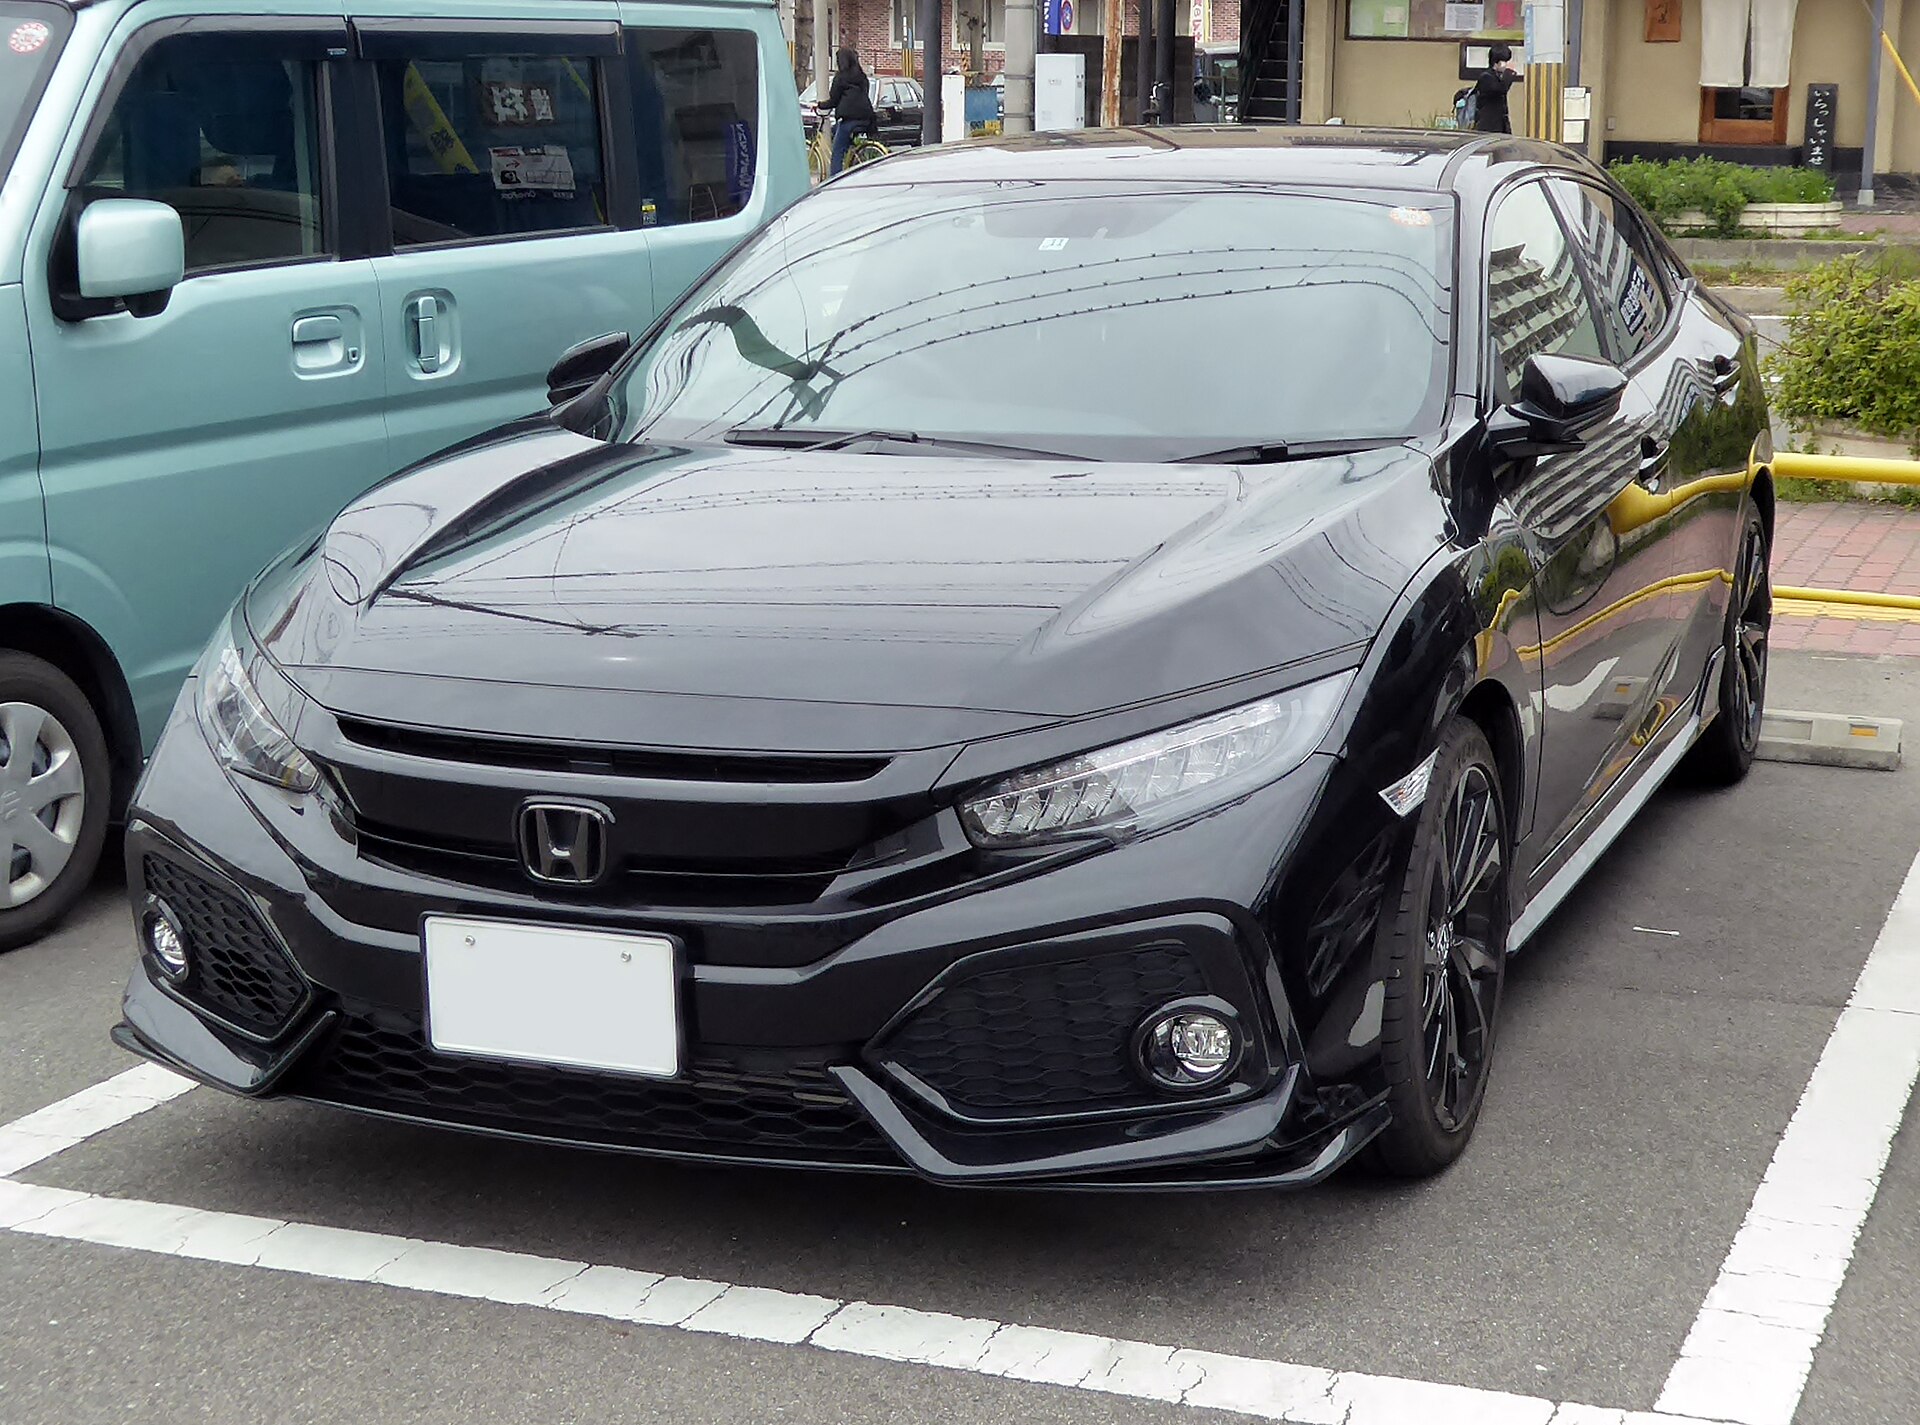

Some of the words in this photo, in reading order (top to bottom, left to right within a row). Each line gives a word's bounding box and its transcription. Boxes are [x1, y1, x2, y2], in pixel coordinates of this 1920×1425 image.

[1808, 90, 1830, 165] いらっしゃいませ
